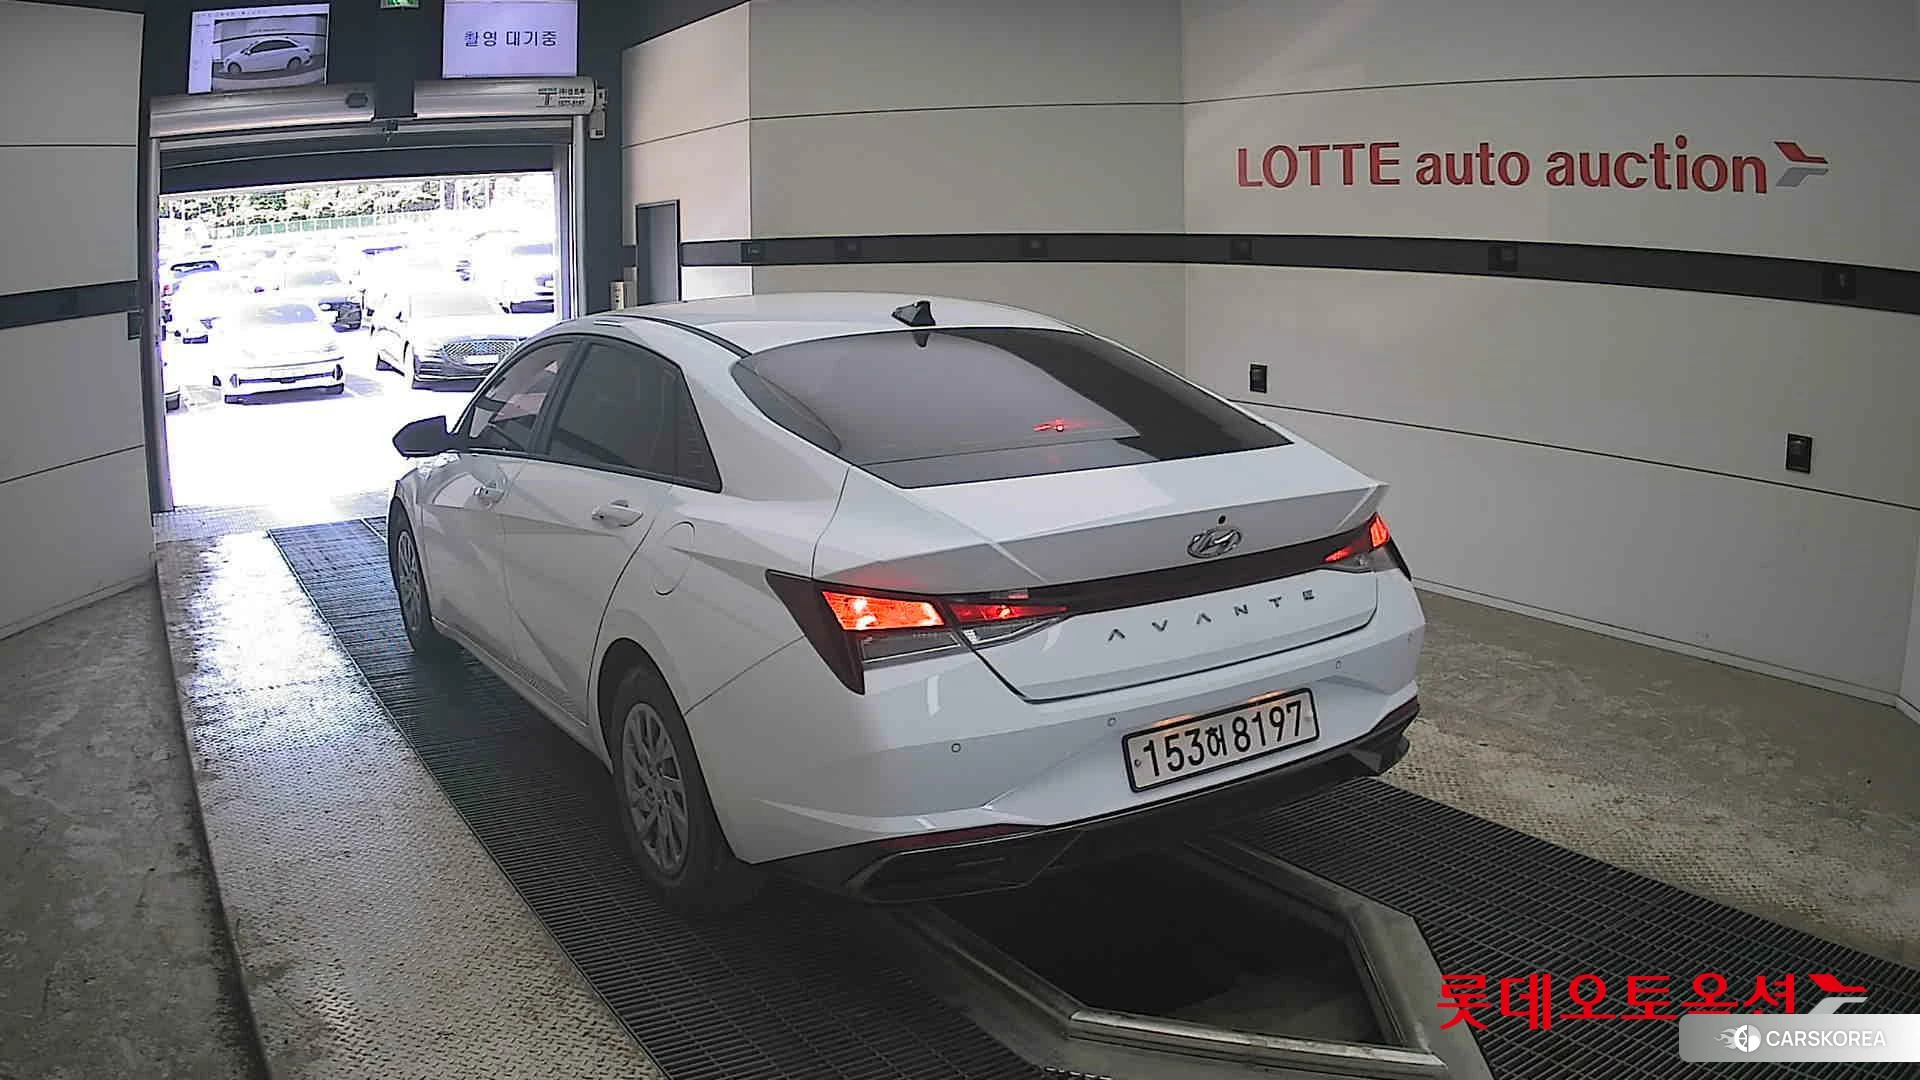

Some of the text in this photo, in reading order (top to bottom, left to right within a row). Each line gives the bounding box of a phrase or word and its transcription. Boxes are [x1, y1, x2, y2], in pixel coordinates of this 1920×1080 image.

[505, 31, 557, 47] 대기중
[1237, 134, 1768, 194] LOTTE auto auction
[1107, 589, 1315, 642] AVANTE
